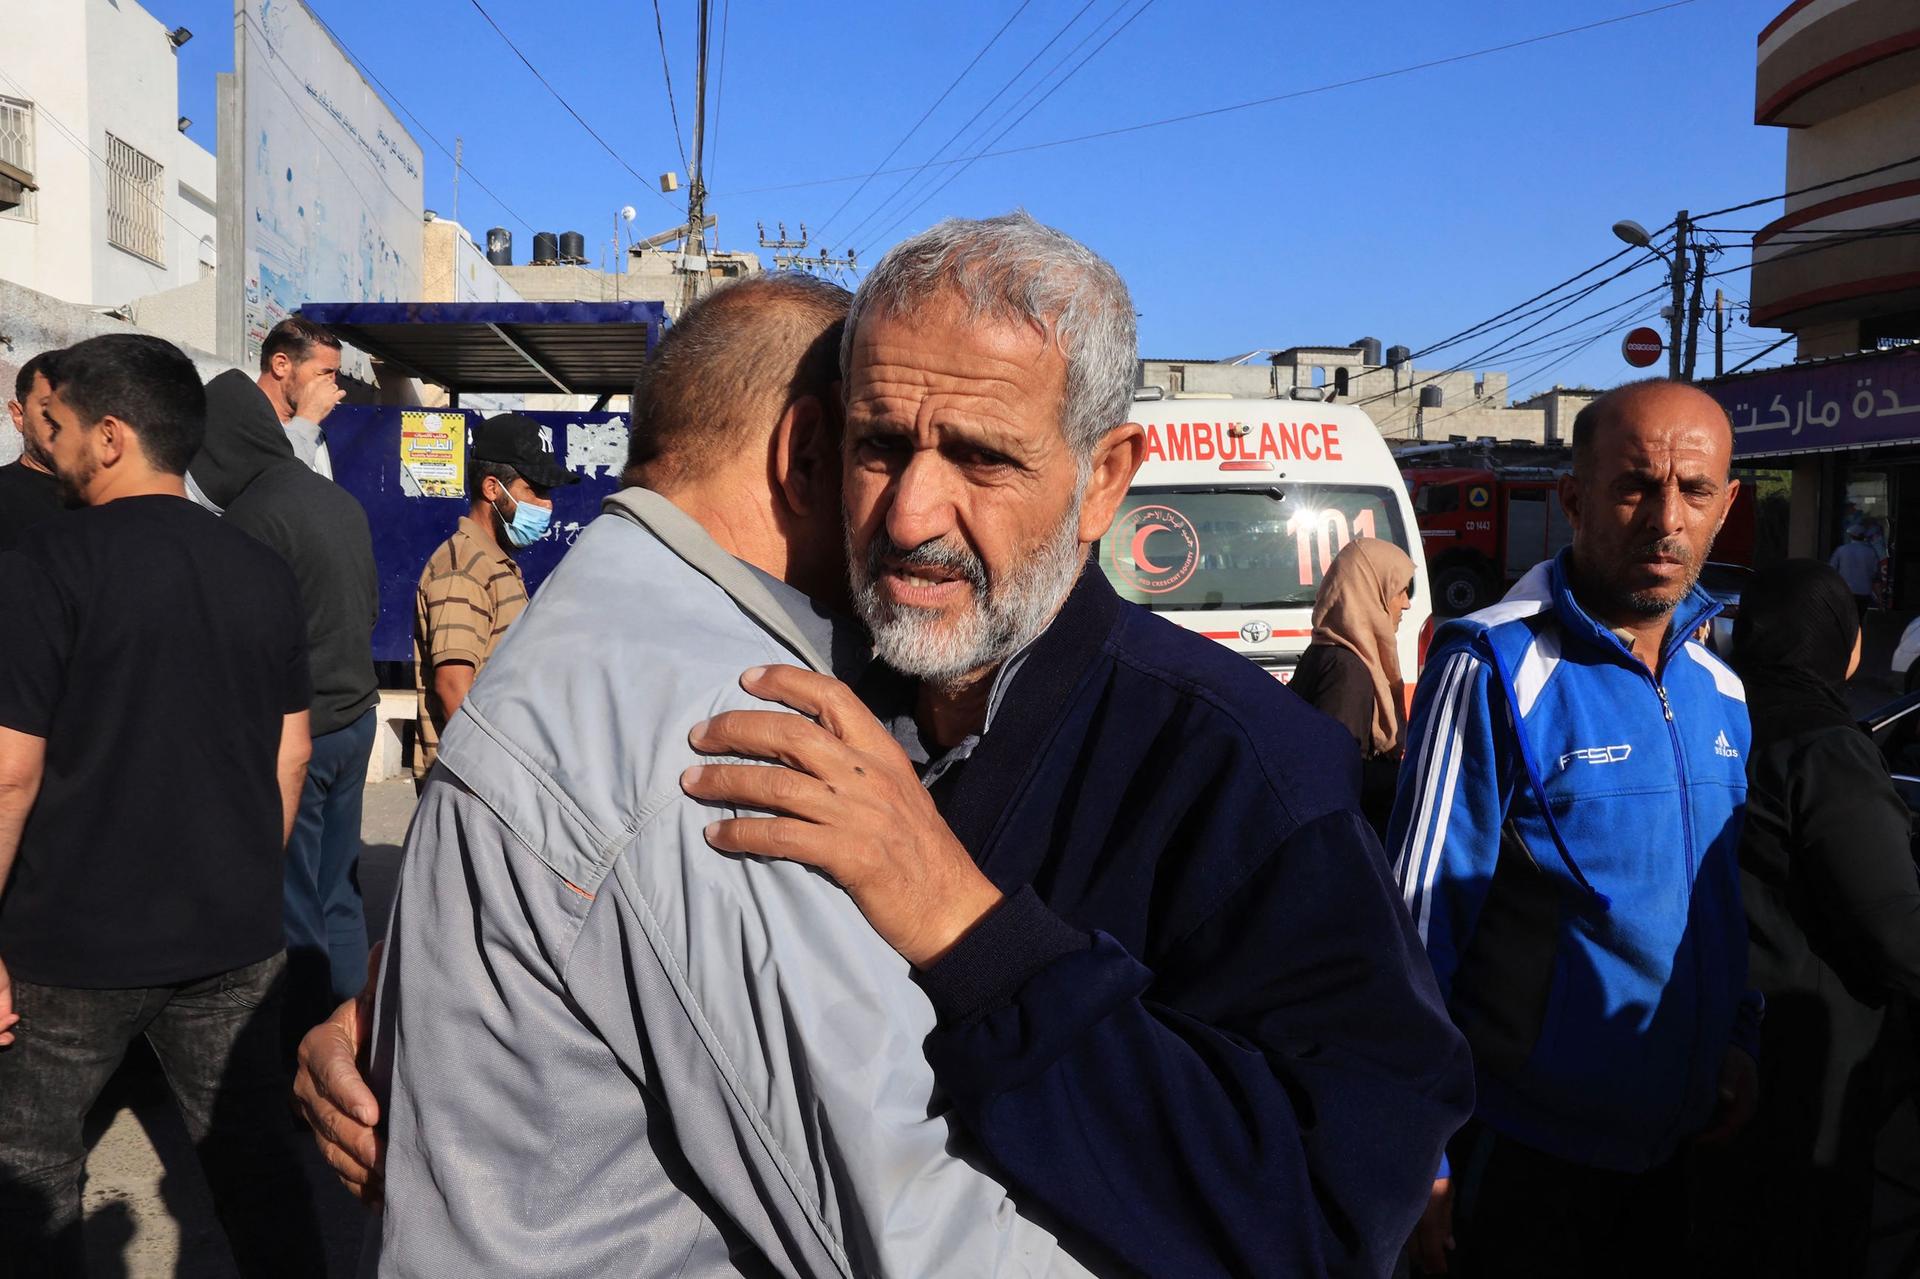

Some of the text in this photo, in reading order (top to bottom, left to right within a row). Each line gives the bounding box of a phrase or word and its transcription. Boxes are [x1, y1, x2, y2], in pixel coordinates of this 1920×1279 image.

[1732, 378, 1920, 436] دة ماركت
[1145, 422, 1343, 461] AMBULANCE
[1151, 572, 1181, 587] CRESCENT
